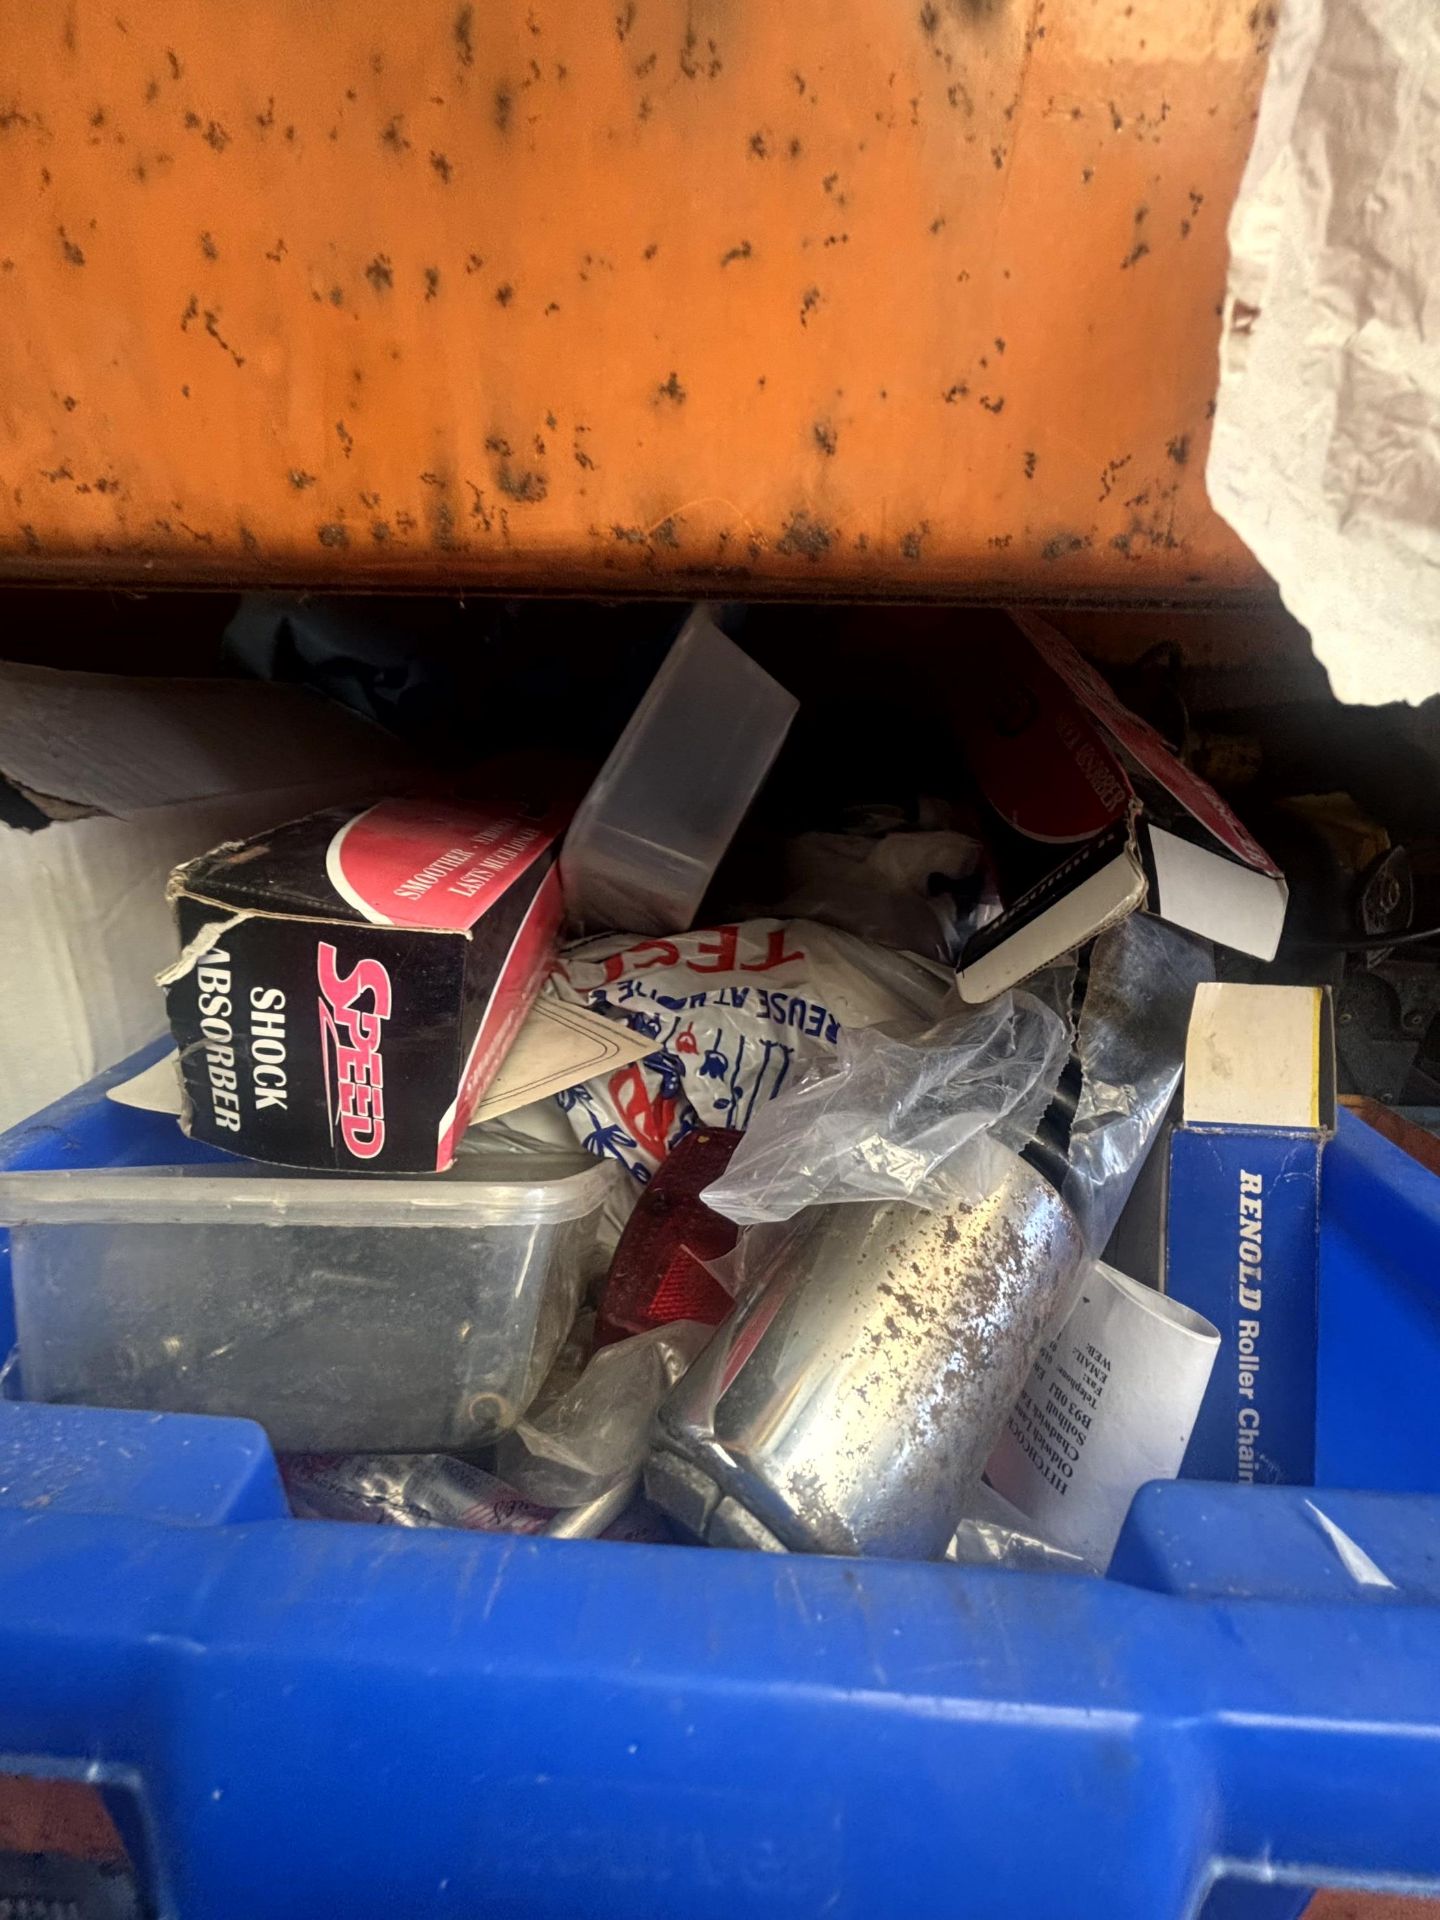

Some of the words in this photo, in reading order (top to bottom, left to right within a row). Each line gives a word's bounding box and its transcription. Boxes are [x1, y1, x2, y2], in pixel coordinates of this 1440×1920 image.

[393, 848, 476, 901] SMOOTHER
[447, 867, 497, 898] LASTS
[479, 847, 520, 872] MUCH
[196, 947, 241, 1133] ABSORBER
[756, 989, 842, 1044] REUSE
[250, 986, 288, 1111] SHOCK
[317, 941, 393, 1159] SPEED
[1238, 1168, 1263, 1312] RENOLD
[1073, 1347, 1108, 1384] EMAIL:
[1086, 1342, 1111, 1372] WEB:
[1238, 1319, 1260, 1400] Roller
[1056, 1364, 1097, 1410] Telephone:
[1083, 1373, 1104, 1396] Fax:
[1033, 1403, 1080, 1463] Chadwick
[1045, 1402, 1087, 1447] Solihull
[1068, 1403, 1092, 1430] B93
[1031, 1428, 1074, 1479] Oldwich
[1238, 1407, 1260, 1484] Chain
